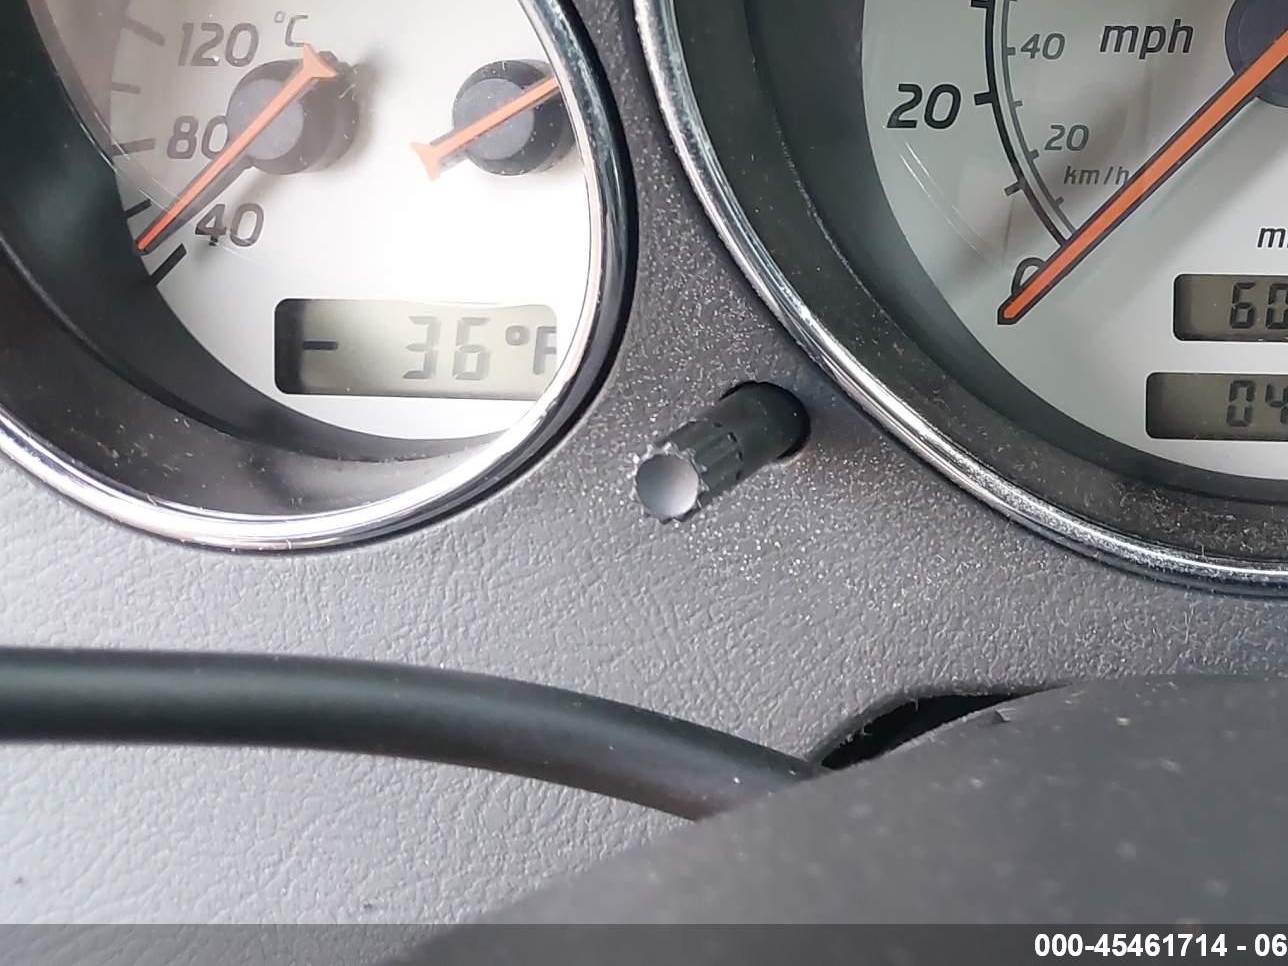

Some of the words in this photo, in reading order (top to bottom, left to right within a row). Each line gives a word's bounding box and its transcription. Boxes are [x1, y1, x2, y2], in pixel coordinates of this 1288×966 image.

[177, 22, 260, 68] 120
[1021, 33, 1066, 60] 40
[1100, 19, 1194, 60] mph
[887, 84, 961, 130] 20
[166, 115, 229, 160] 80
[1044, 124, 1090, 152] 20
[194, 202, 265, 248] 40
